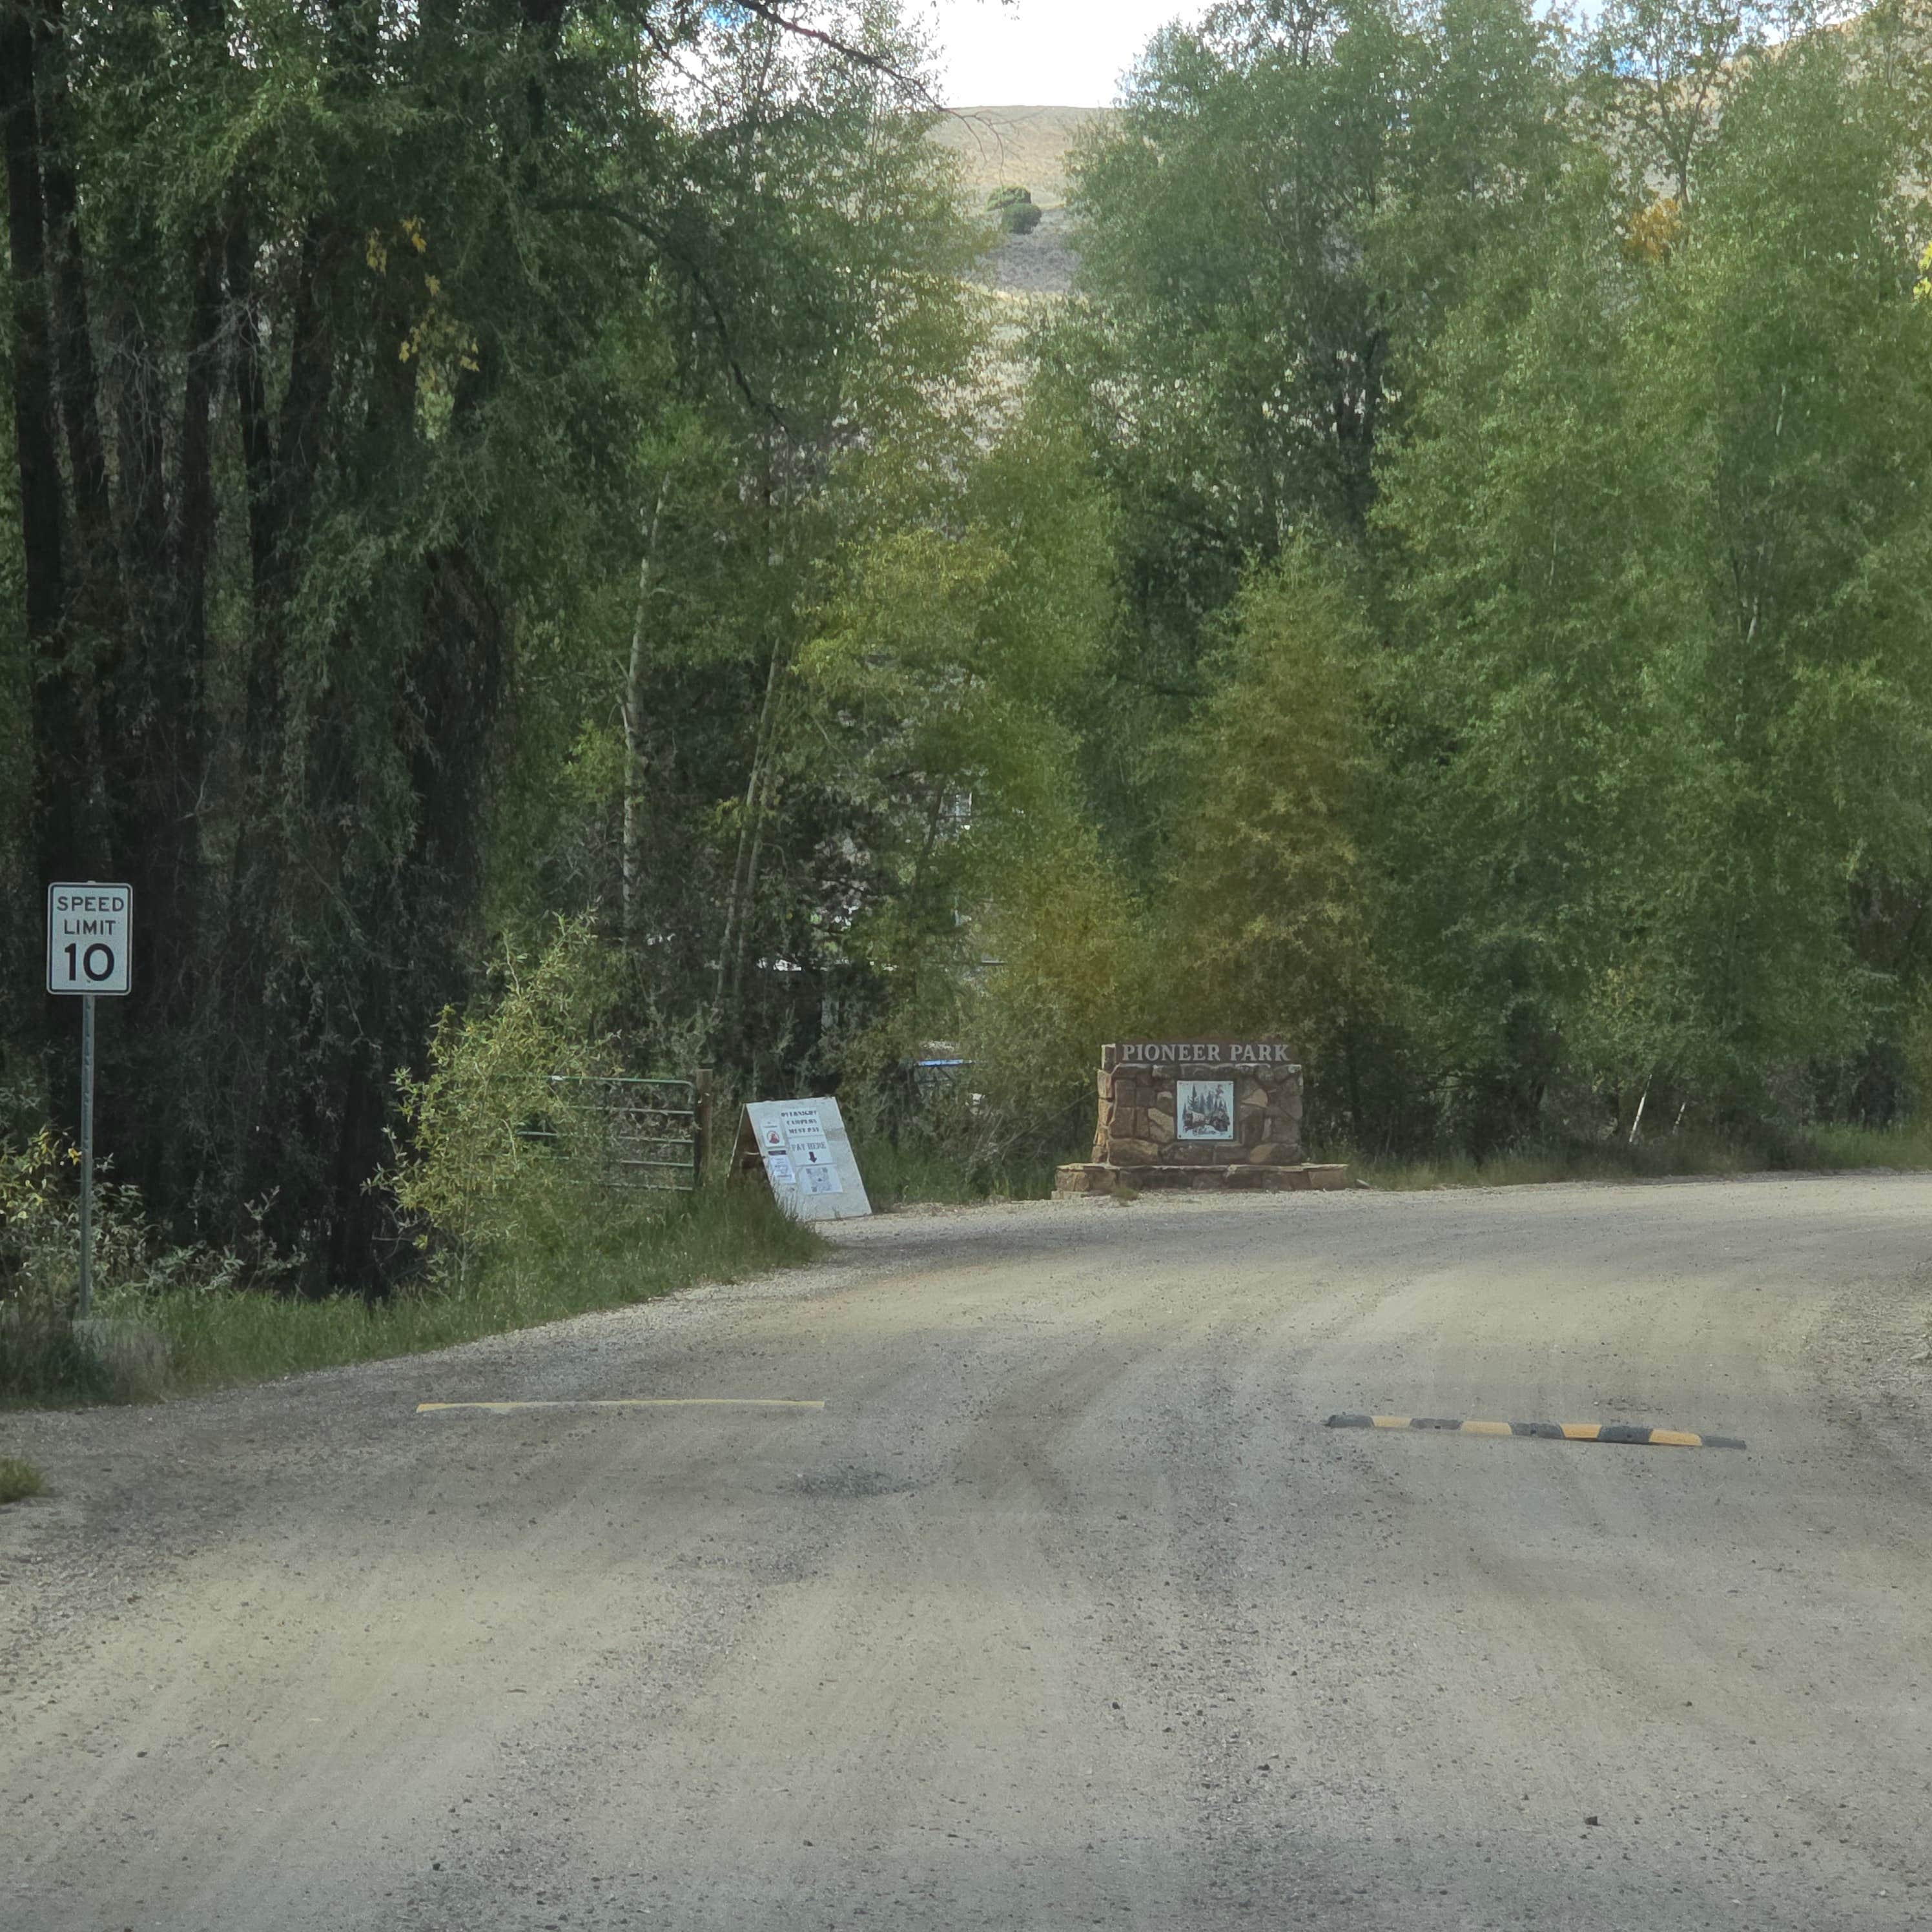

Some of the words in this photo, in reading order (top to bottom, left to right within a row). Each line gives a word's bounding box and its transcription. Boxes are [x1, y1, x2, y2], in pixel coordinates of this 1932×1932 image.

[57, 896, 124, 912] SPEED
[64, 919, 116, 935] LIMIT
[65, 943, 115, 981] 10
[1122, 1043, 1220, 1062] PIONEER
[1229, 1043, 1290, 1061] PARK
[791, 1143, 807, 1151] PAY
[807, 1142, 827, 1150] HERE
